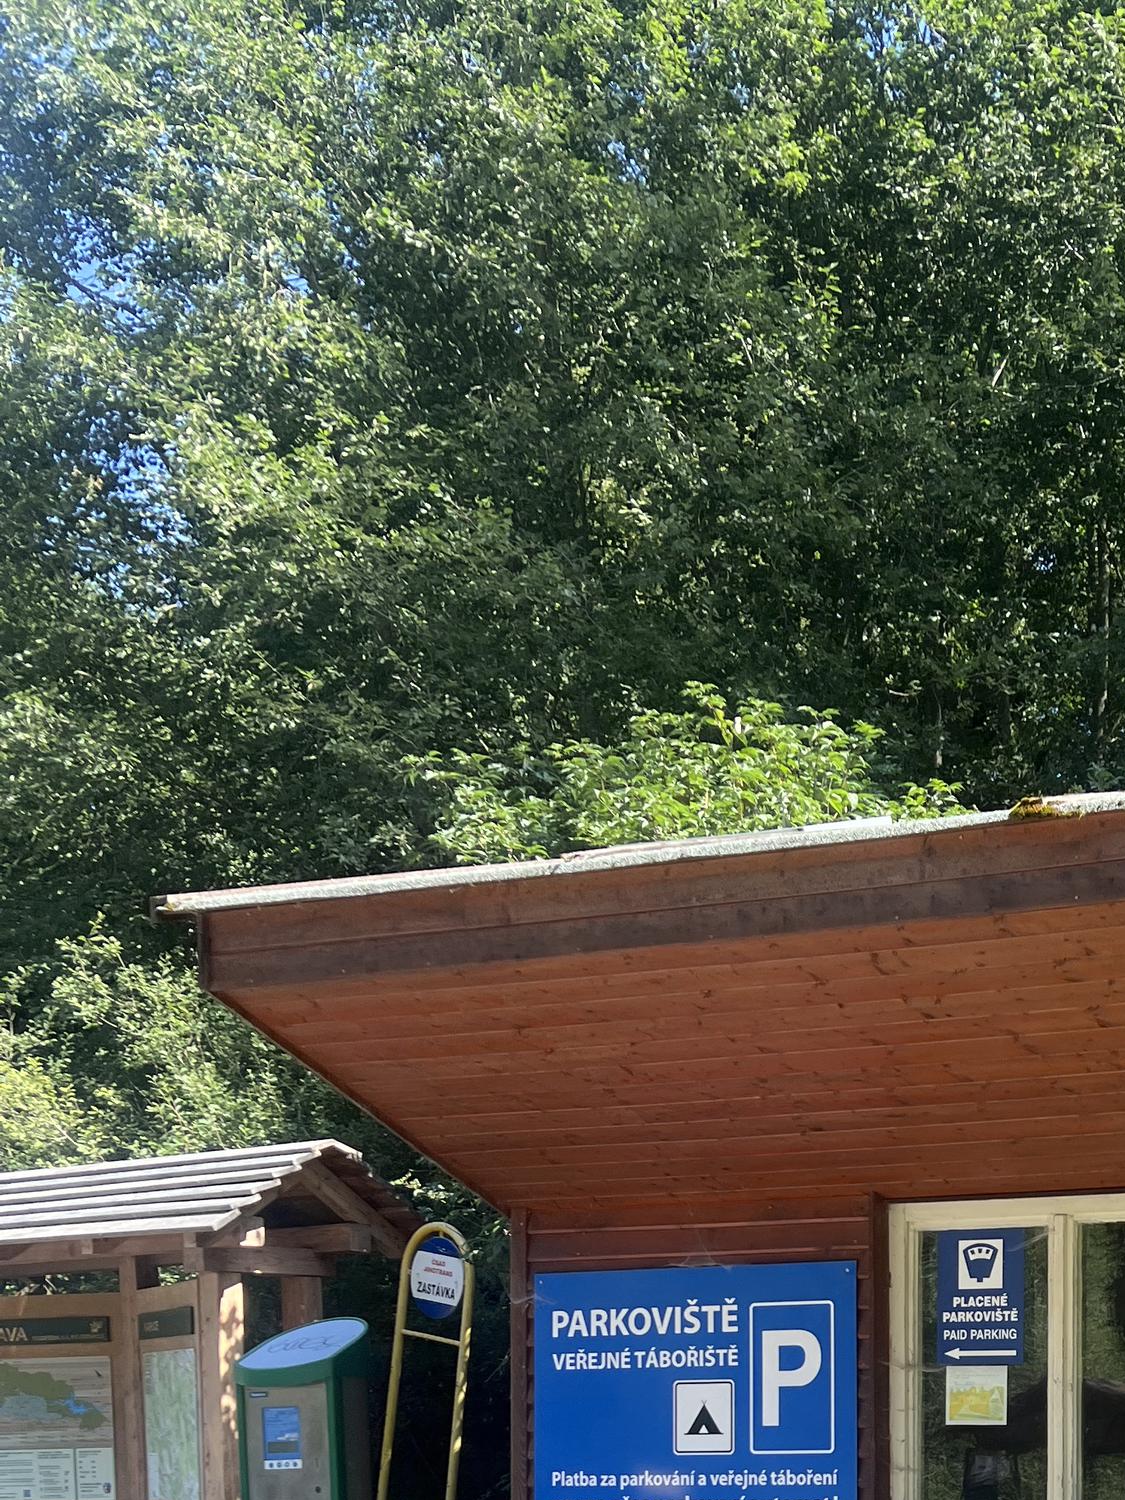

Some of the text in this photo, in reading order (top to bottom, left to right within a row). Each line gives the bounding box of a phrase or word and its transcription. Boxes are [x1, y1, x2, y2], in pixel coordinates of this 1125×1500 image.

[417, 1281, 455, 1300] ZASTÁVKA
[953, 1293, 1008, 1308] PLACENÉ
[552, 1298, 739, 1338] PARKOVIŠTĚ
[942, 1308, 1019, 1323] PARKOVIŠTĚ
[943, 1329, 1017, 1340] PAID PARKING
[552, 1345, 739, 1370] VEŘEJNÉ TÁBOŘIŠTĚ
[761, 1329, 822, 1427] P
[552, 1469, 838, 1490] Platba za parkování a veřejné táboření
